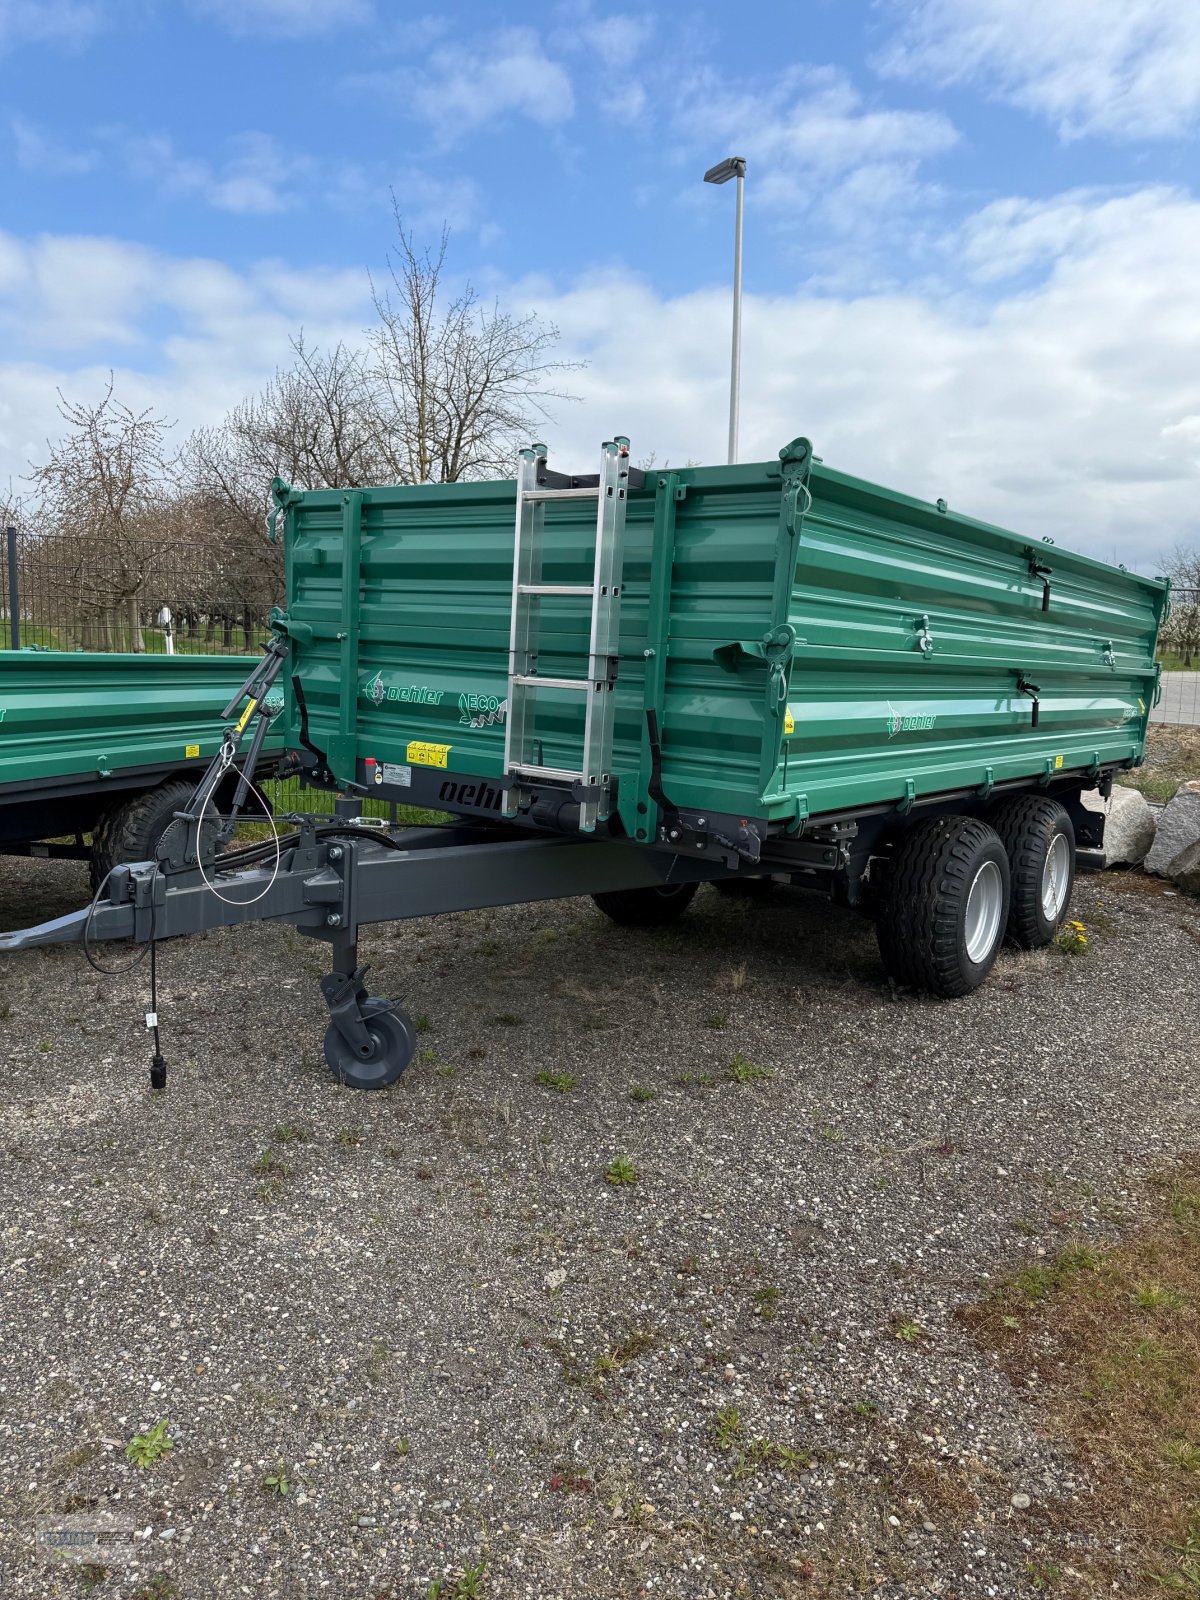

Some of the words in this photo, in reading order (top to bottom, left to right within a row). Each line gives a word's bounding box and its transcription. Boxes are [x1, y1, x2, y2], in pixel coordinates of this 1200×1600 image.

[386, 685, 444, 705] oehler
[467, 693, 499, 712] ECO
[902, 712, 937, 731] oehler
